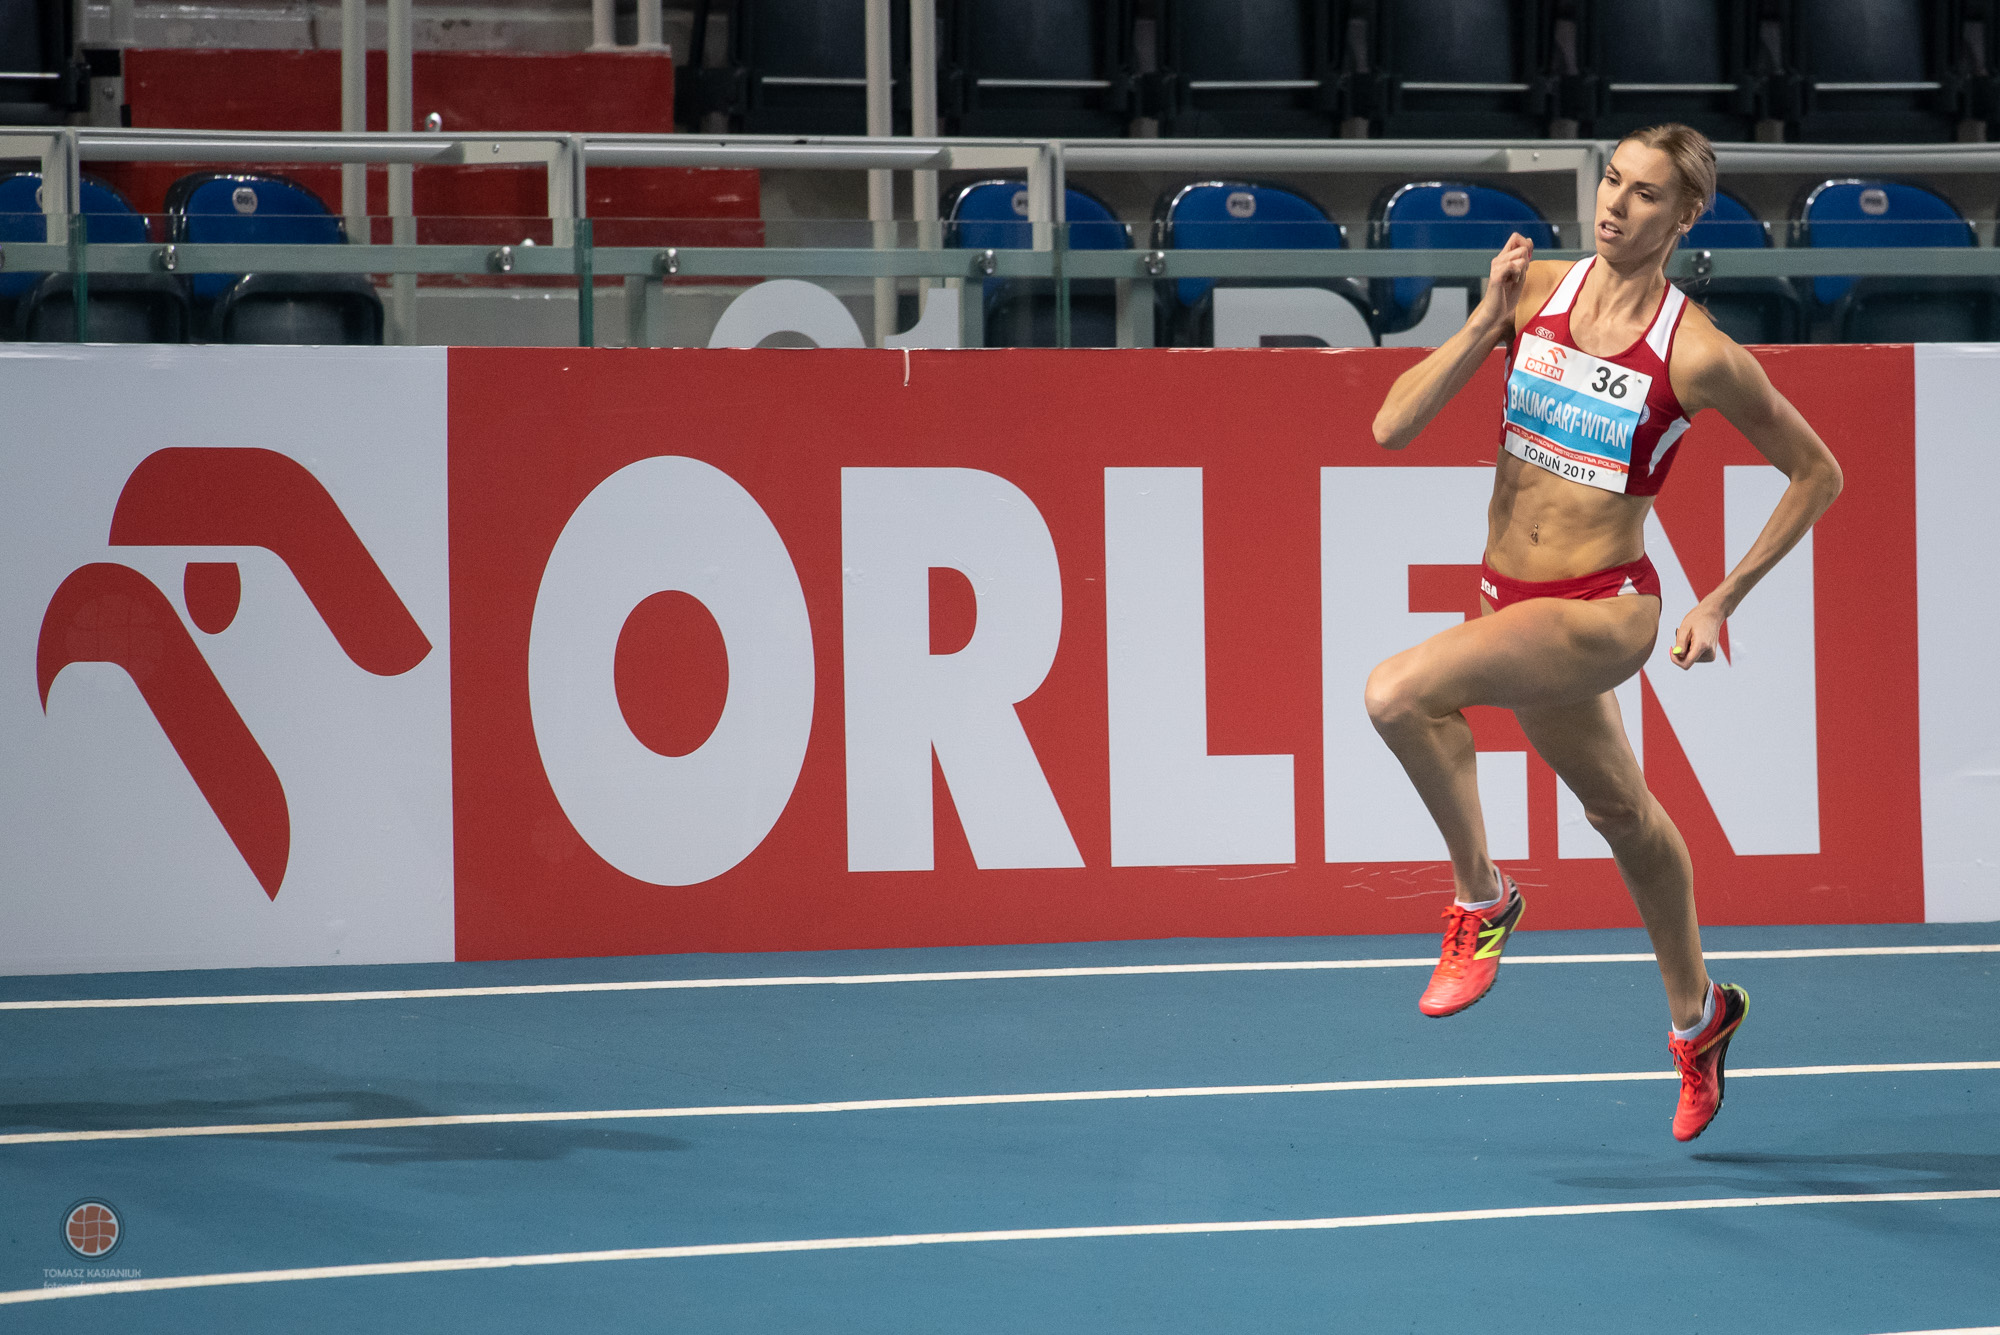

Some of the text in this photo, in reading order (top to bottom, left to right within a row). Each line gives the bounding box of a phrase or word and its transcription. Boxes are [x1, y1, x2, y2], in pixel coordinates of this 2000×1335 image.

[1526, 359, 1562, 380] ORLEN
[1591, 366, 1630, 399] 36
[1510, 384, 1629, 449] BAUMGART-WITAN
[1524, 444, 1596, 482] TORUŃ 2019
[528, 455, 1821, 886] ORLEN
